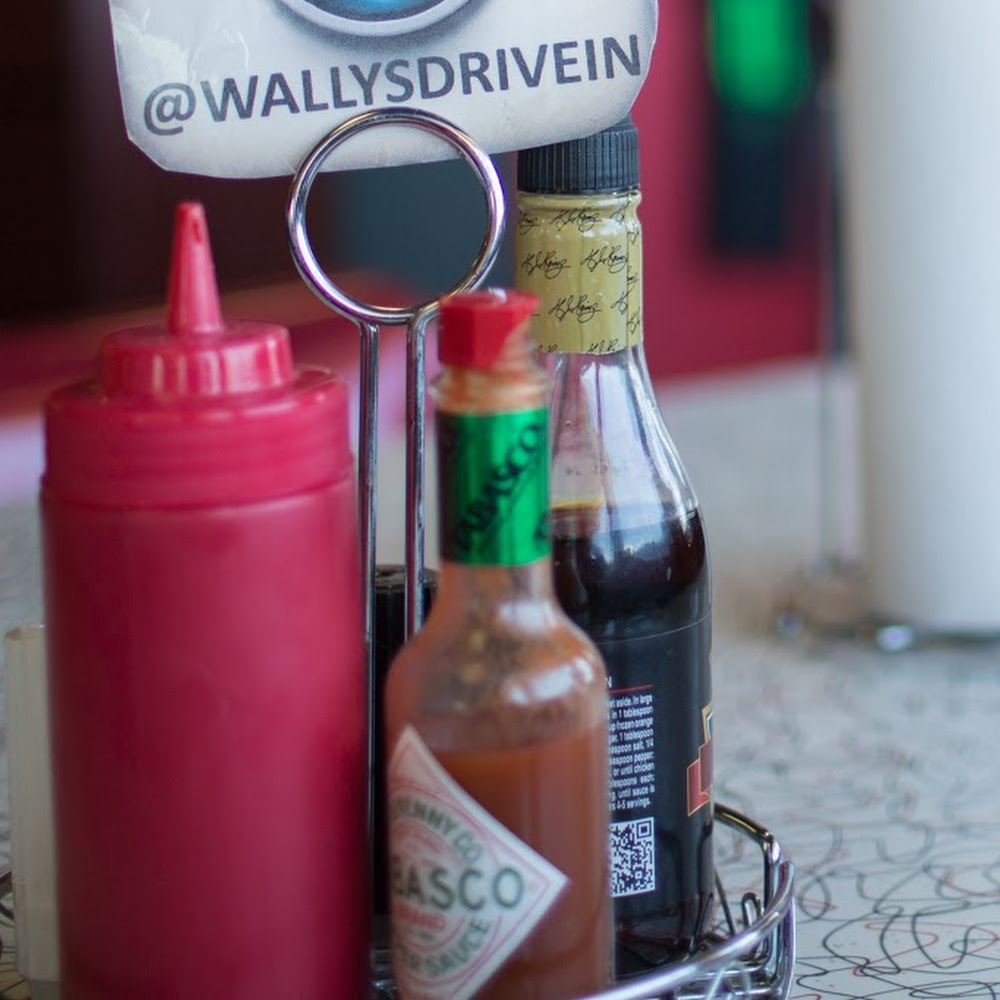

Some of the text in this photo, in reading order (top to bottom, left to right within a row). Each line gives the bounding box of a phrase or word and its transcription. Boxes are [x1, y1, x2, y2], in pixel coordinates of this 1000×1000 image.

[143, 34, 642, 136] @WALLYSDRIVEIN
[623, 705, 654, 718] tablespoon
[623, 728, 654, 741] tablespoon
[633, 762, 655, 774] chicken
